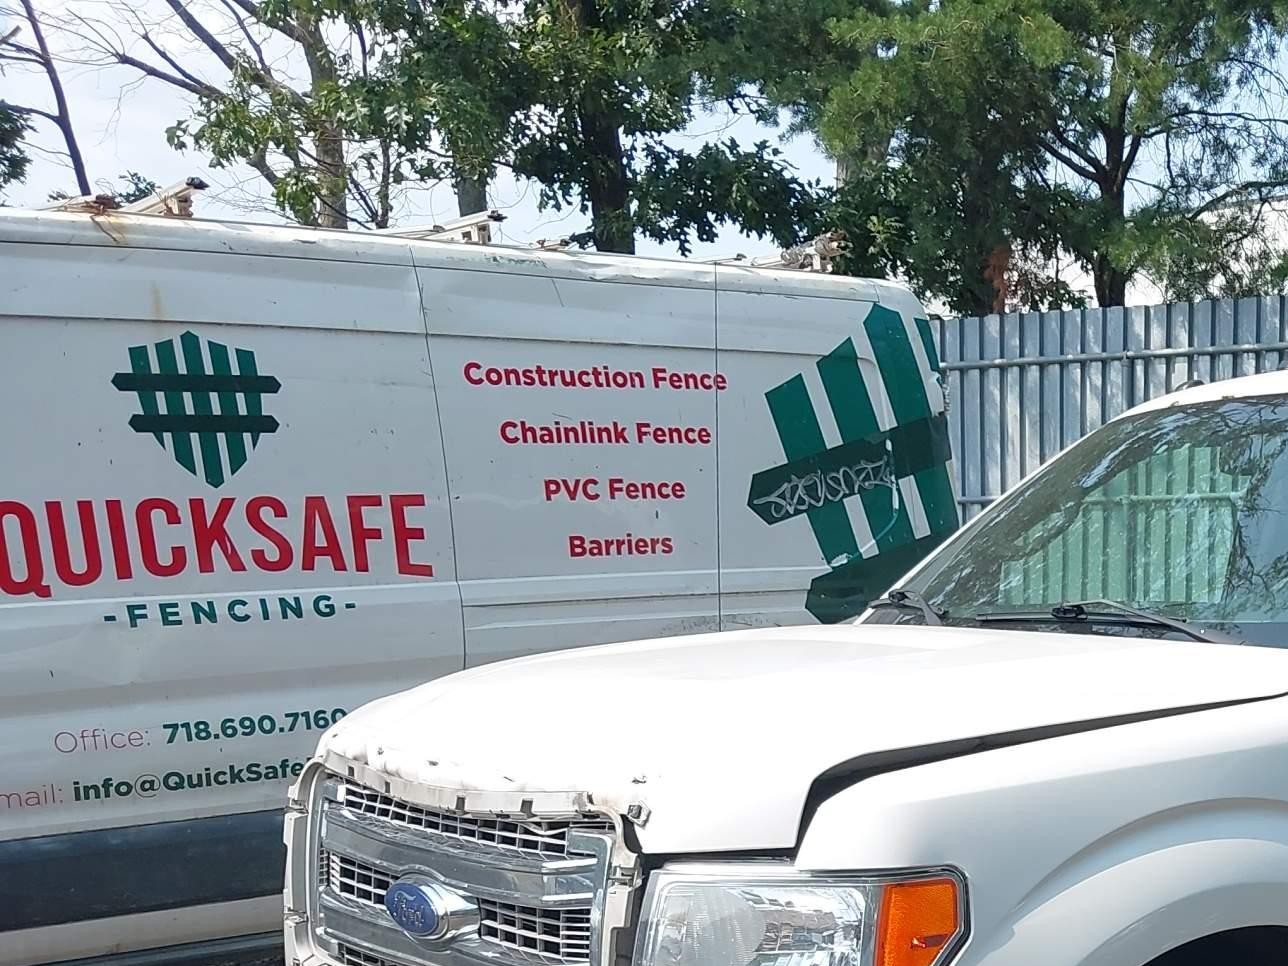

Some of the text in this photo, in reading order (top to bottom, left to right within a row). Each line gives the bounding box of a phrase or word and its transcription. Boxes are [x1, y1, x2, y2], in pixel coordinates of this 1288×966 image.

[463, 362, 727, 391] Construction Fence
[499, 420, 712, 444] Chainlink Fence
[543, 478, 686, 502] PVC Fence
[0, 494, 434, 598] QUICKSAFE
[568, 532, 674, 558] Barriers
[54, 708, 348, 754] Office: 718.690.7160
[72, 756, 314, 802] info@QuickSafe
